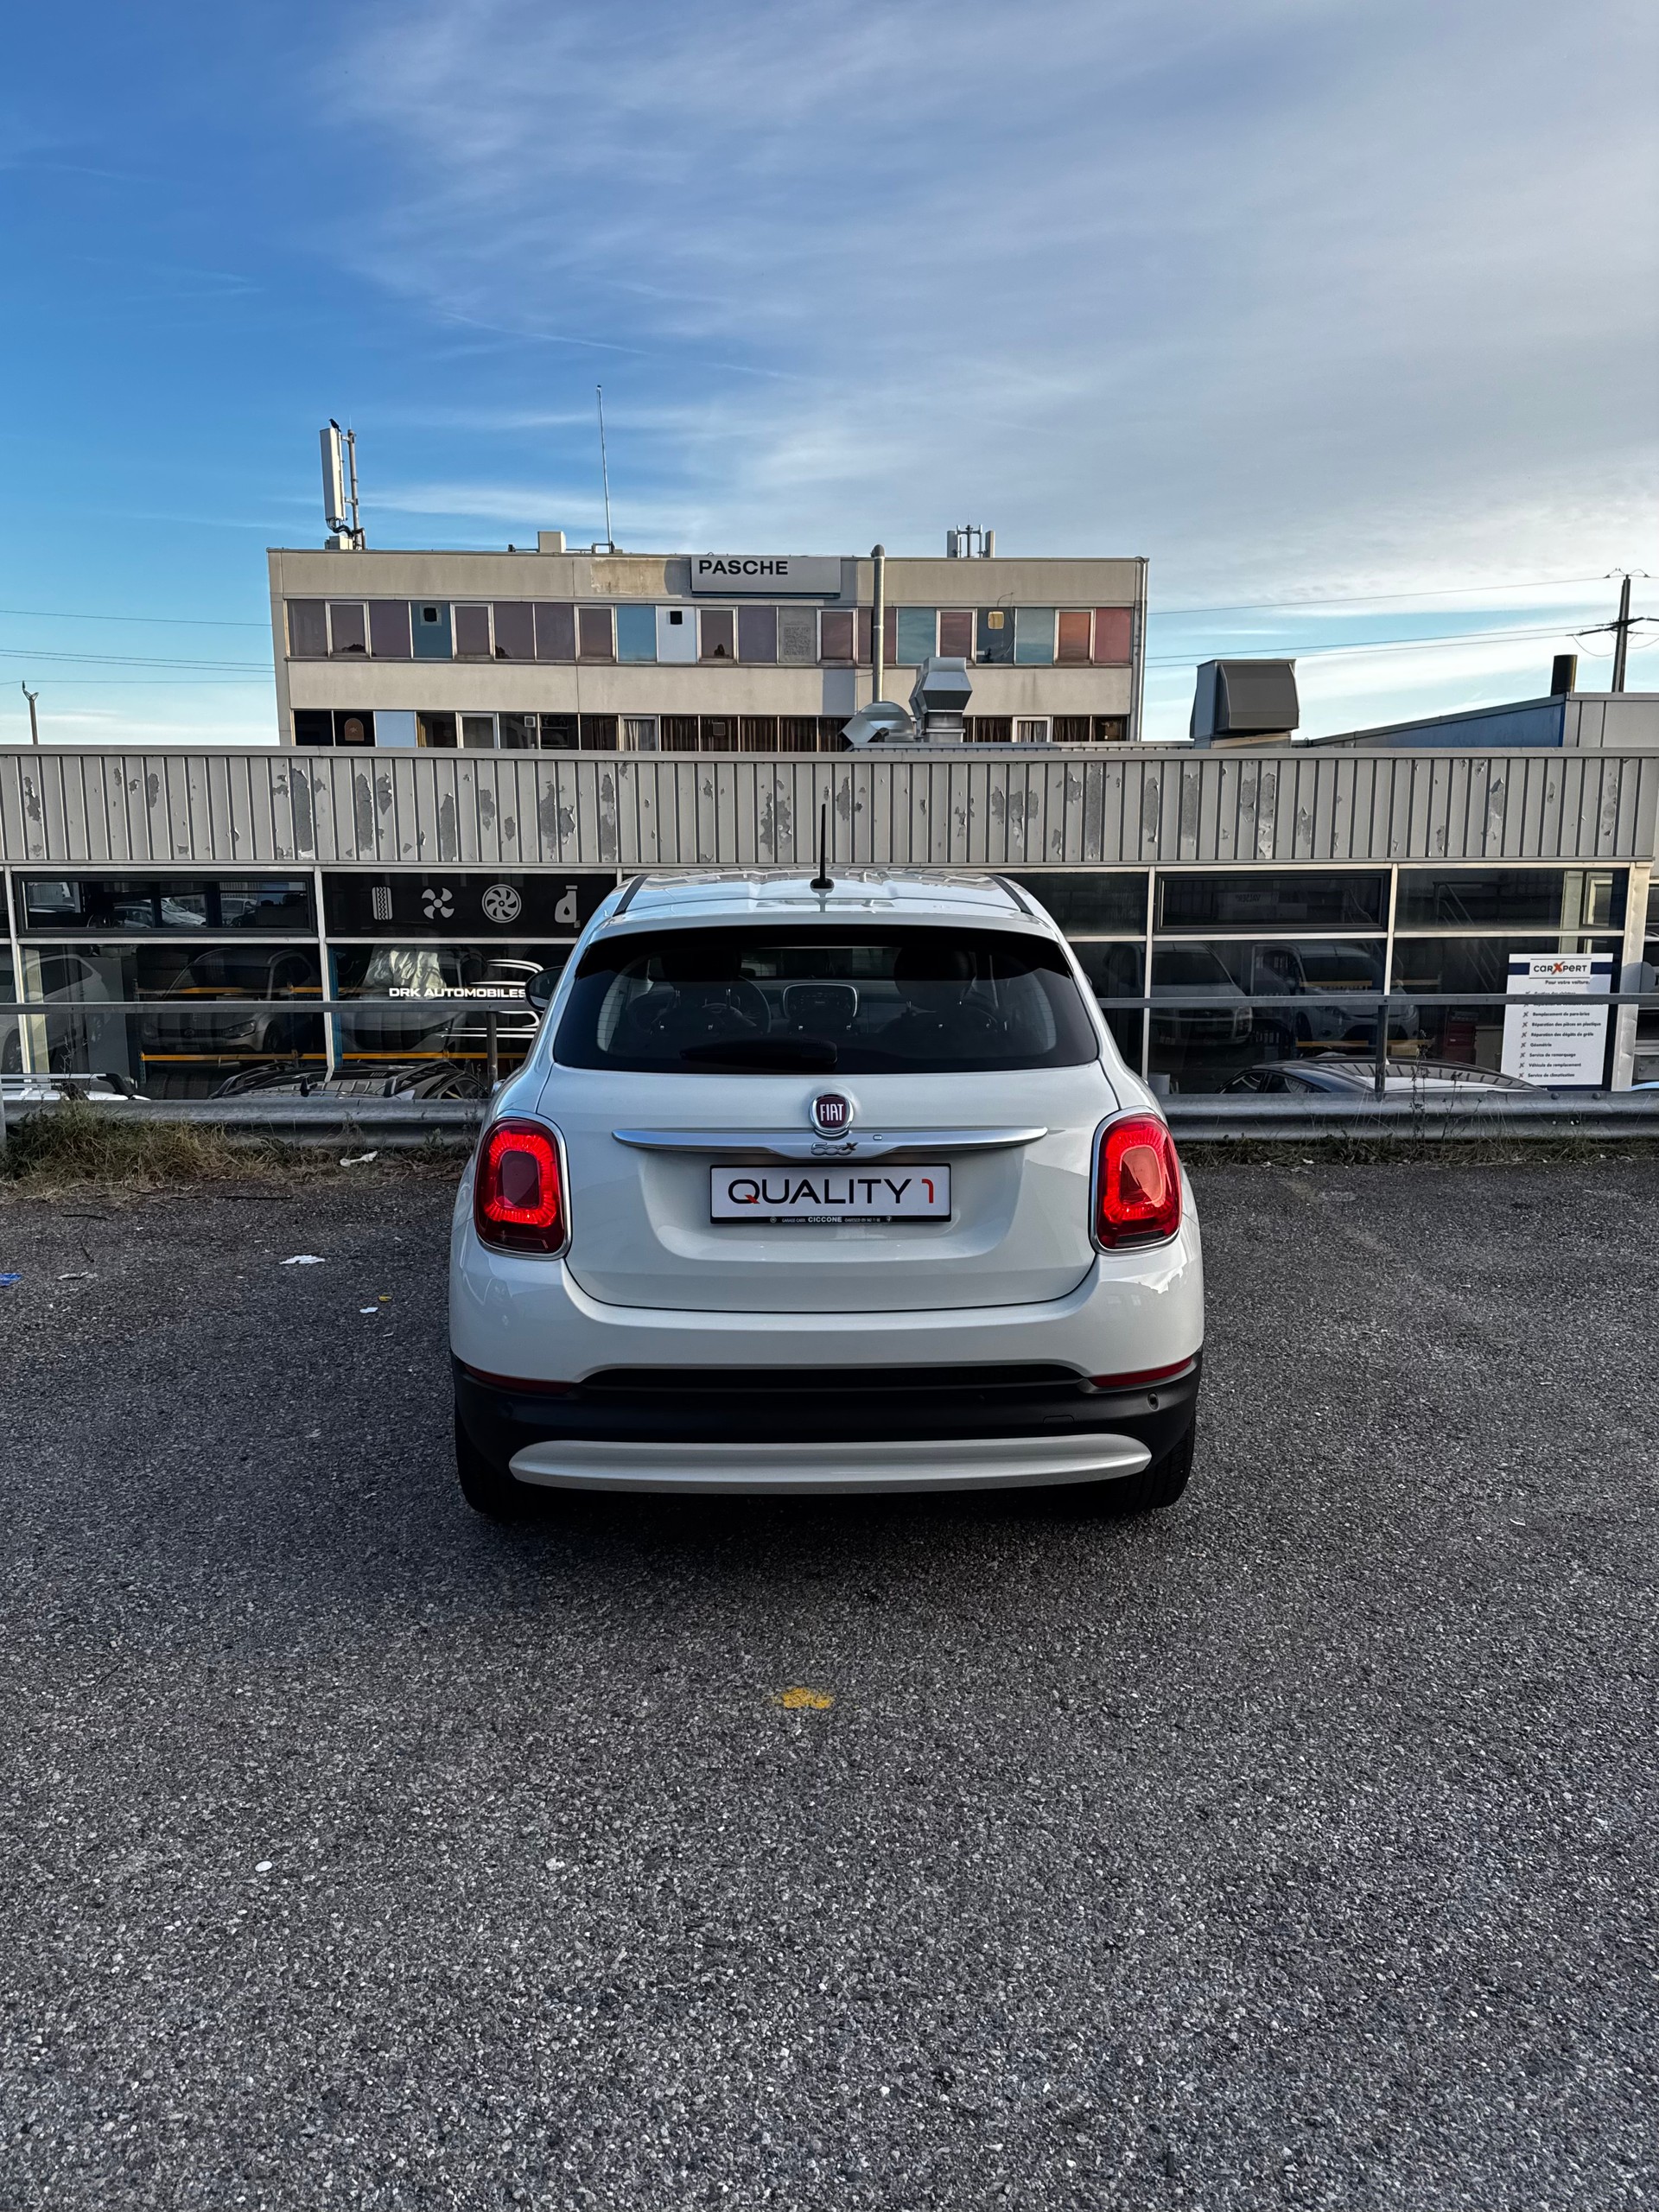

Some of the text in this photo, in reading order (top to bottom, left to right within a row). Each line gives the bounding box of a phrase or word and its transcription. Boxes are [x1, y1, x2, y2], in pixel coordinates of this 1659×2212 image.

[698, 559, 788, 575] PASCHE
[389, 988, 526, 998] DRK AUTOMOBILES
[820, 1103, 844, 1121] FIAT
[728, 1179, 934, 1204] QUALITY 1
